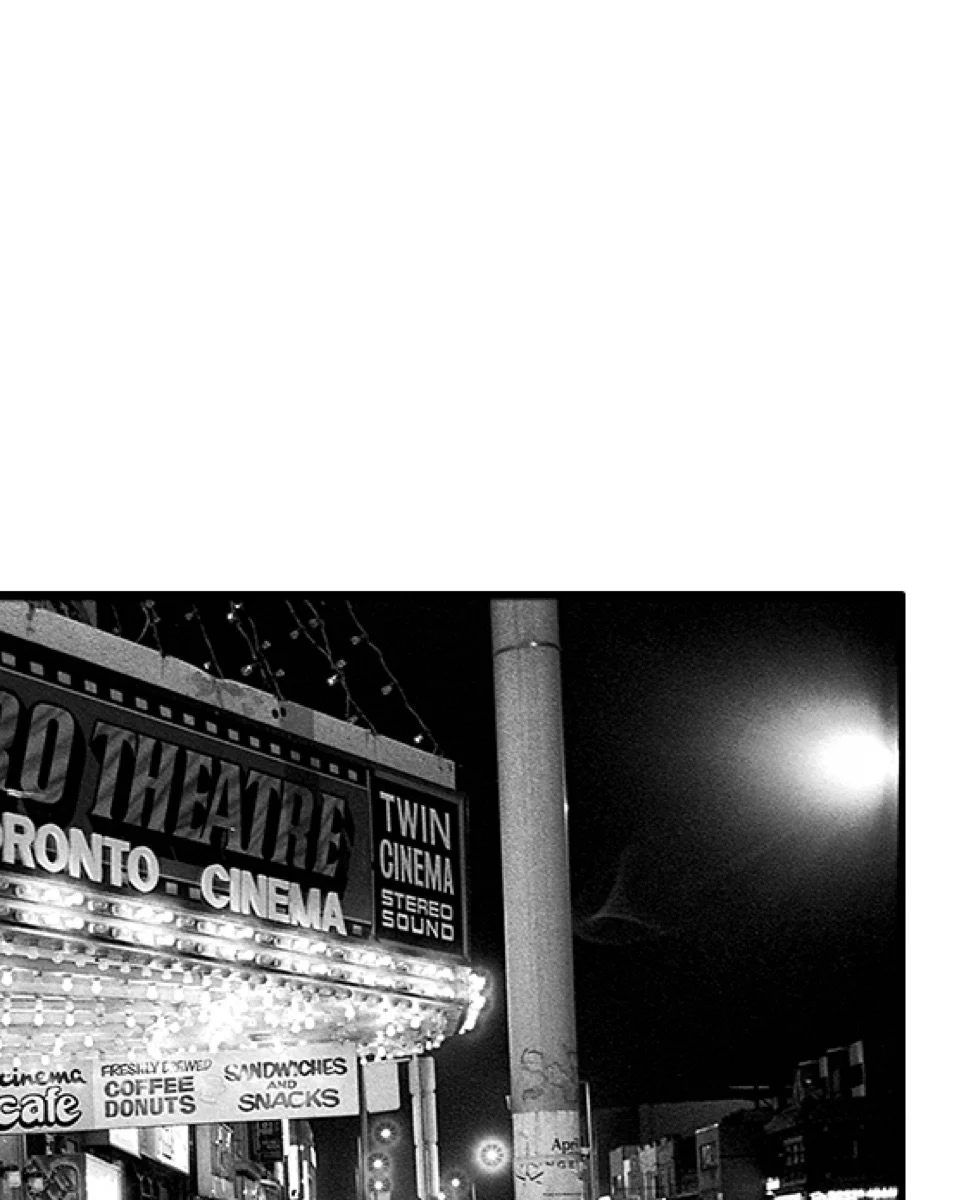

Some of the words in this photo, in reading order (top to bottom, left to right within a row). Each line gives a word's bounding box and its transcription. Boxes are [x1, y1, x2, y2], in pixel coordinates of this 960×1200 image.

[90, 720, 346, 878] THEATRE
[378, 790, 452, 851] TWIN
[378, 838, 455, 896] CINEMA
[200, 862, 348, 937] CINEMA
[380, 888, 454, 922] STEREO
[381, 908, 455, 942] SOUND
[104, 1076, 195, 1098] COFFEE
[237, 1087, 341, 1113] SNACKS
[266, 1080, 298, 1090] AND
[104, 1094, 197, 1118] DONUTS
[551, 1136, 581, 1155] Apri
